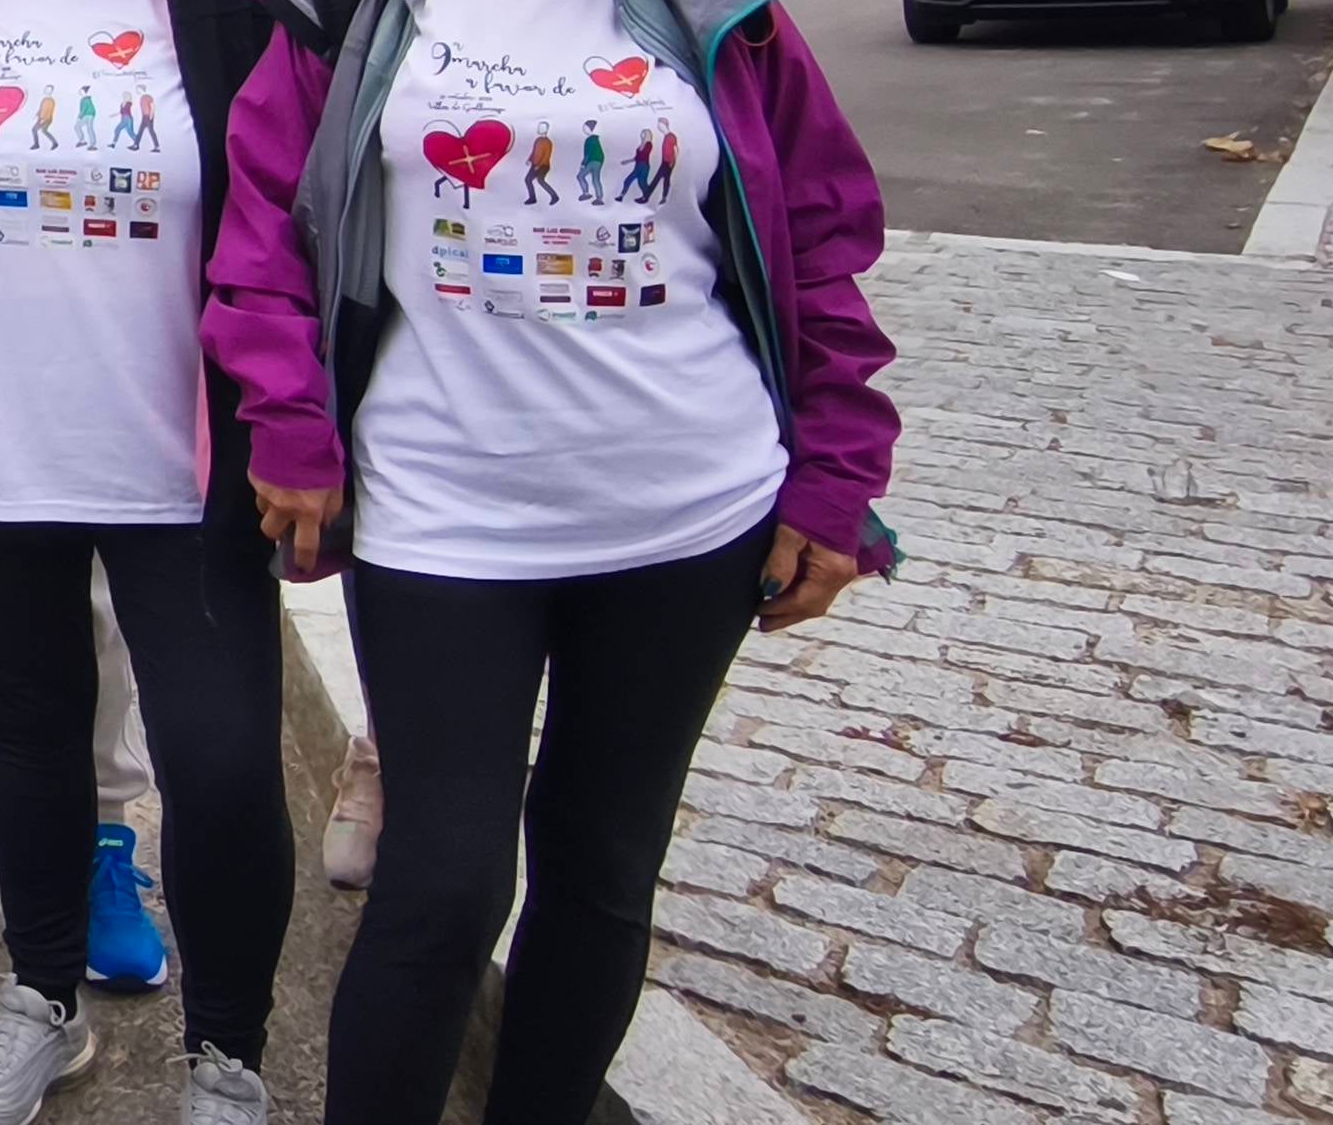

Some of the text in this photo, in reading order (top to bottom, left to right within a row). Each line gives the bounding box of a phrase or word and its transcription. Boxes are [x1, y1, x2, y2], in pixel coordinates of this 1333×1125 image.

[451, 55, 527, 76] marcha
[483, 74, 546, 96] favor
[552, 76, 576, 96] de
